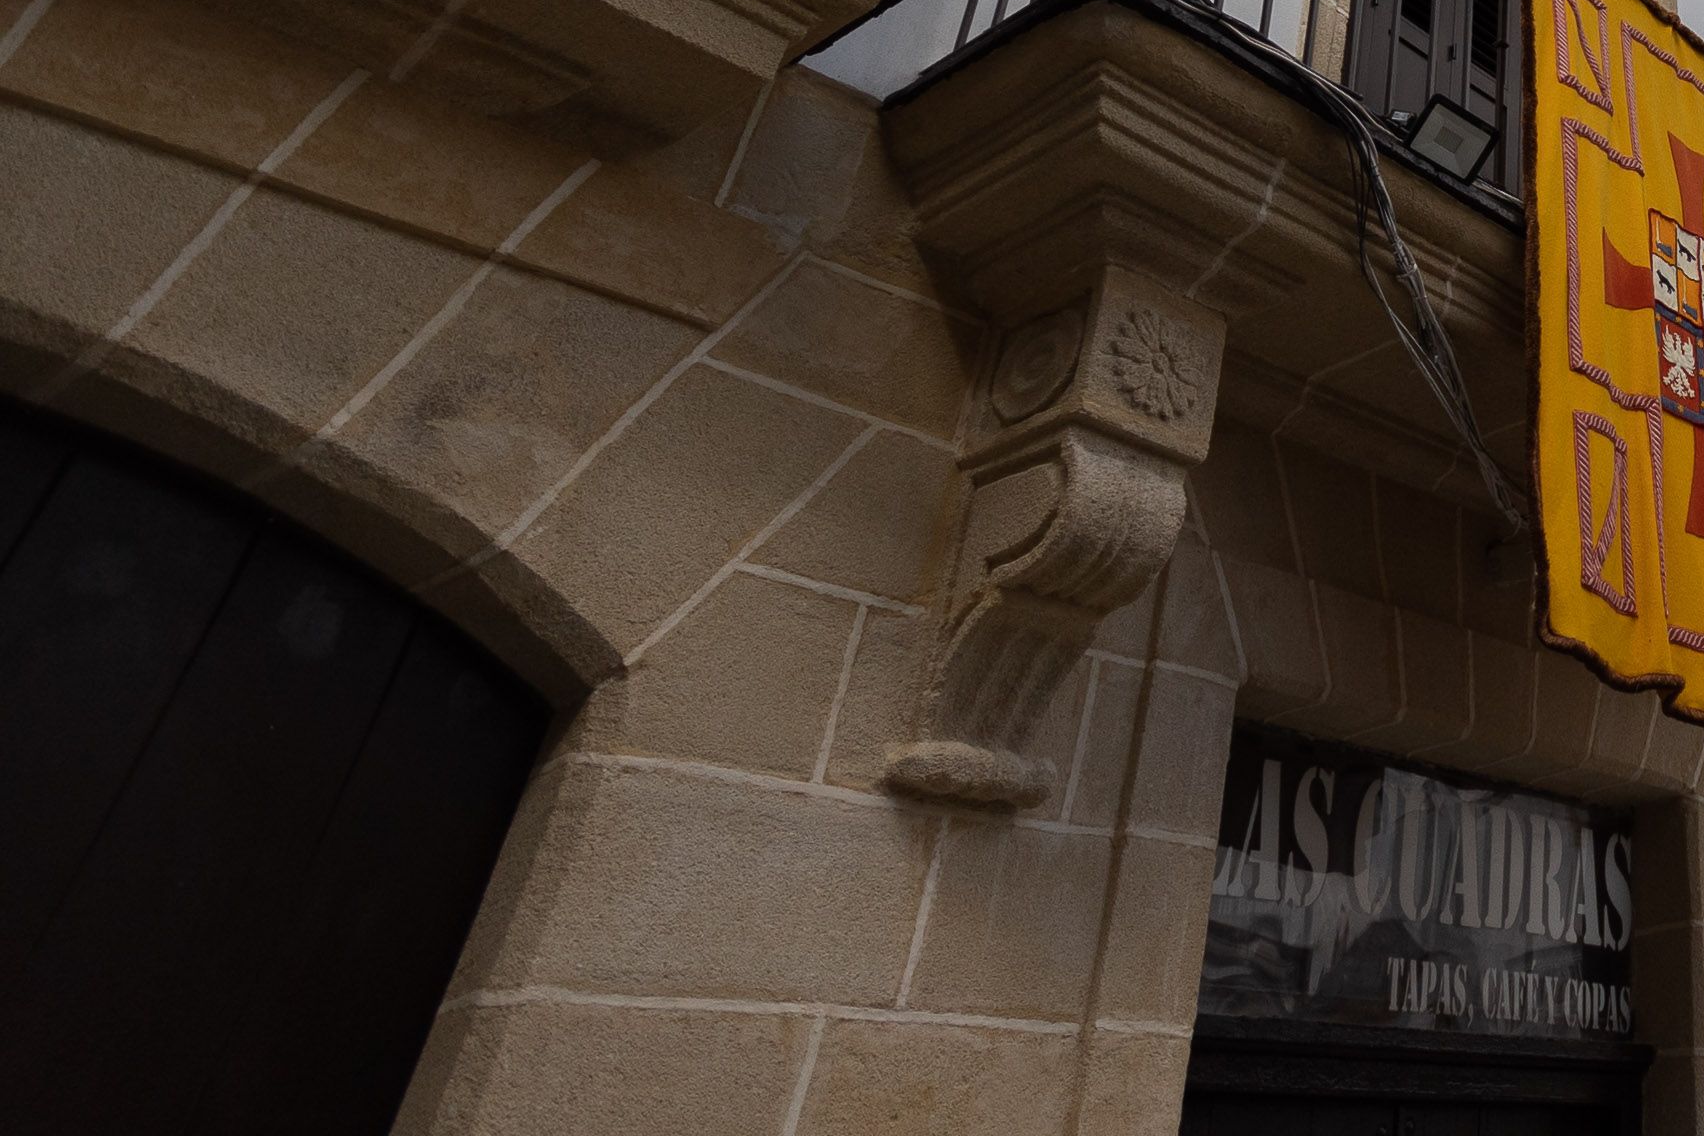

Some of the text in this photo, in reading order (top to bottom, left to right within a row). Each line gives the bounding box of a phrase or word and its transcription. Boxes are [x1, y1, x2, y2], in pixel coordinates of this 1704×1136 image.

[1353, 778, 1632, 953] CUADRAS
[1387, 956, 1632, 1033] TAPAS, CAFÉ Y COPAS
